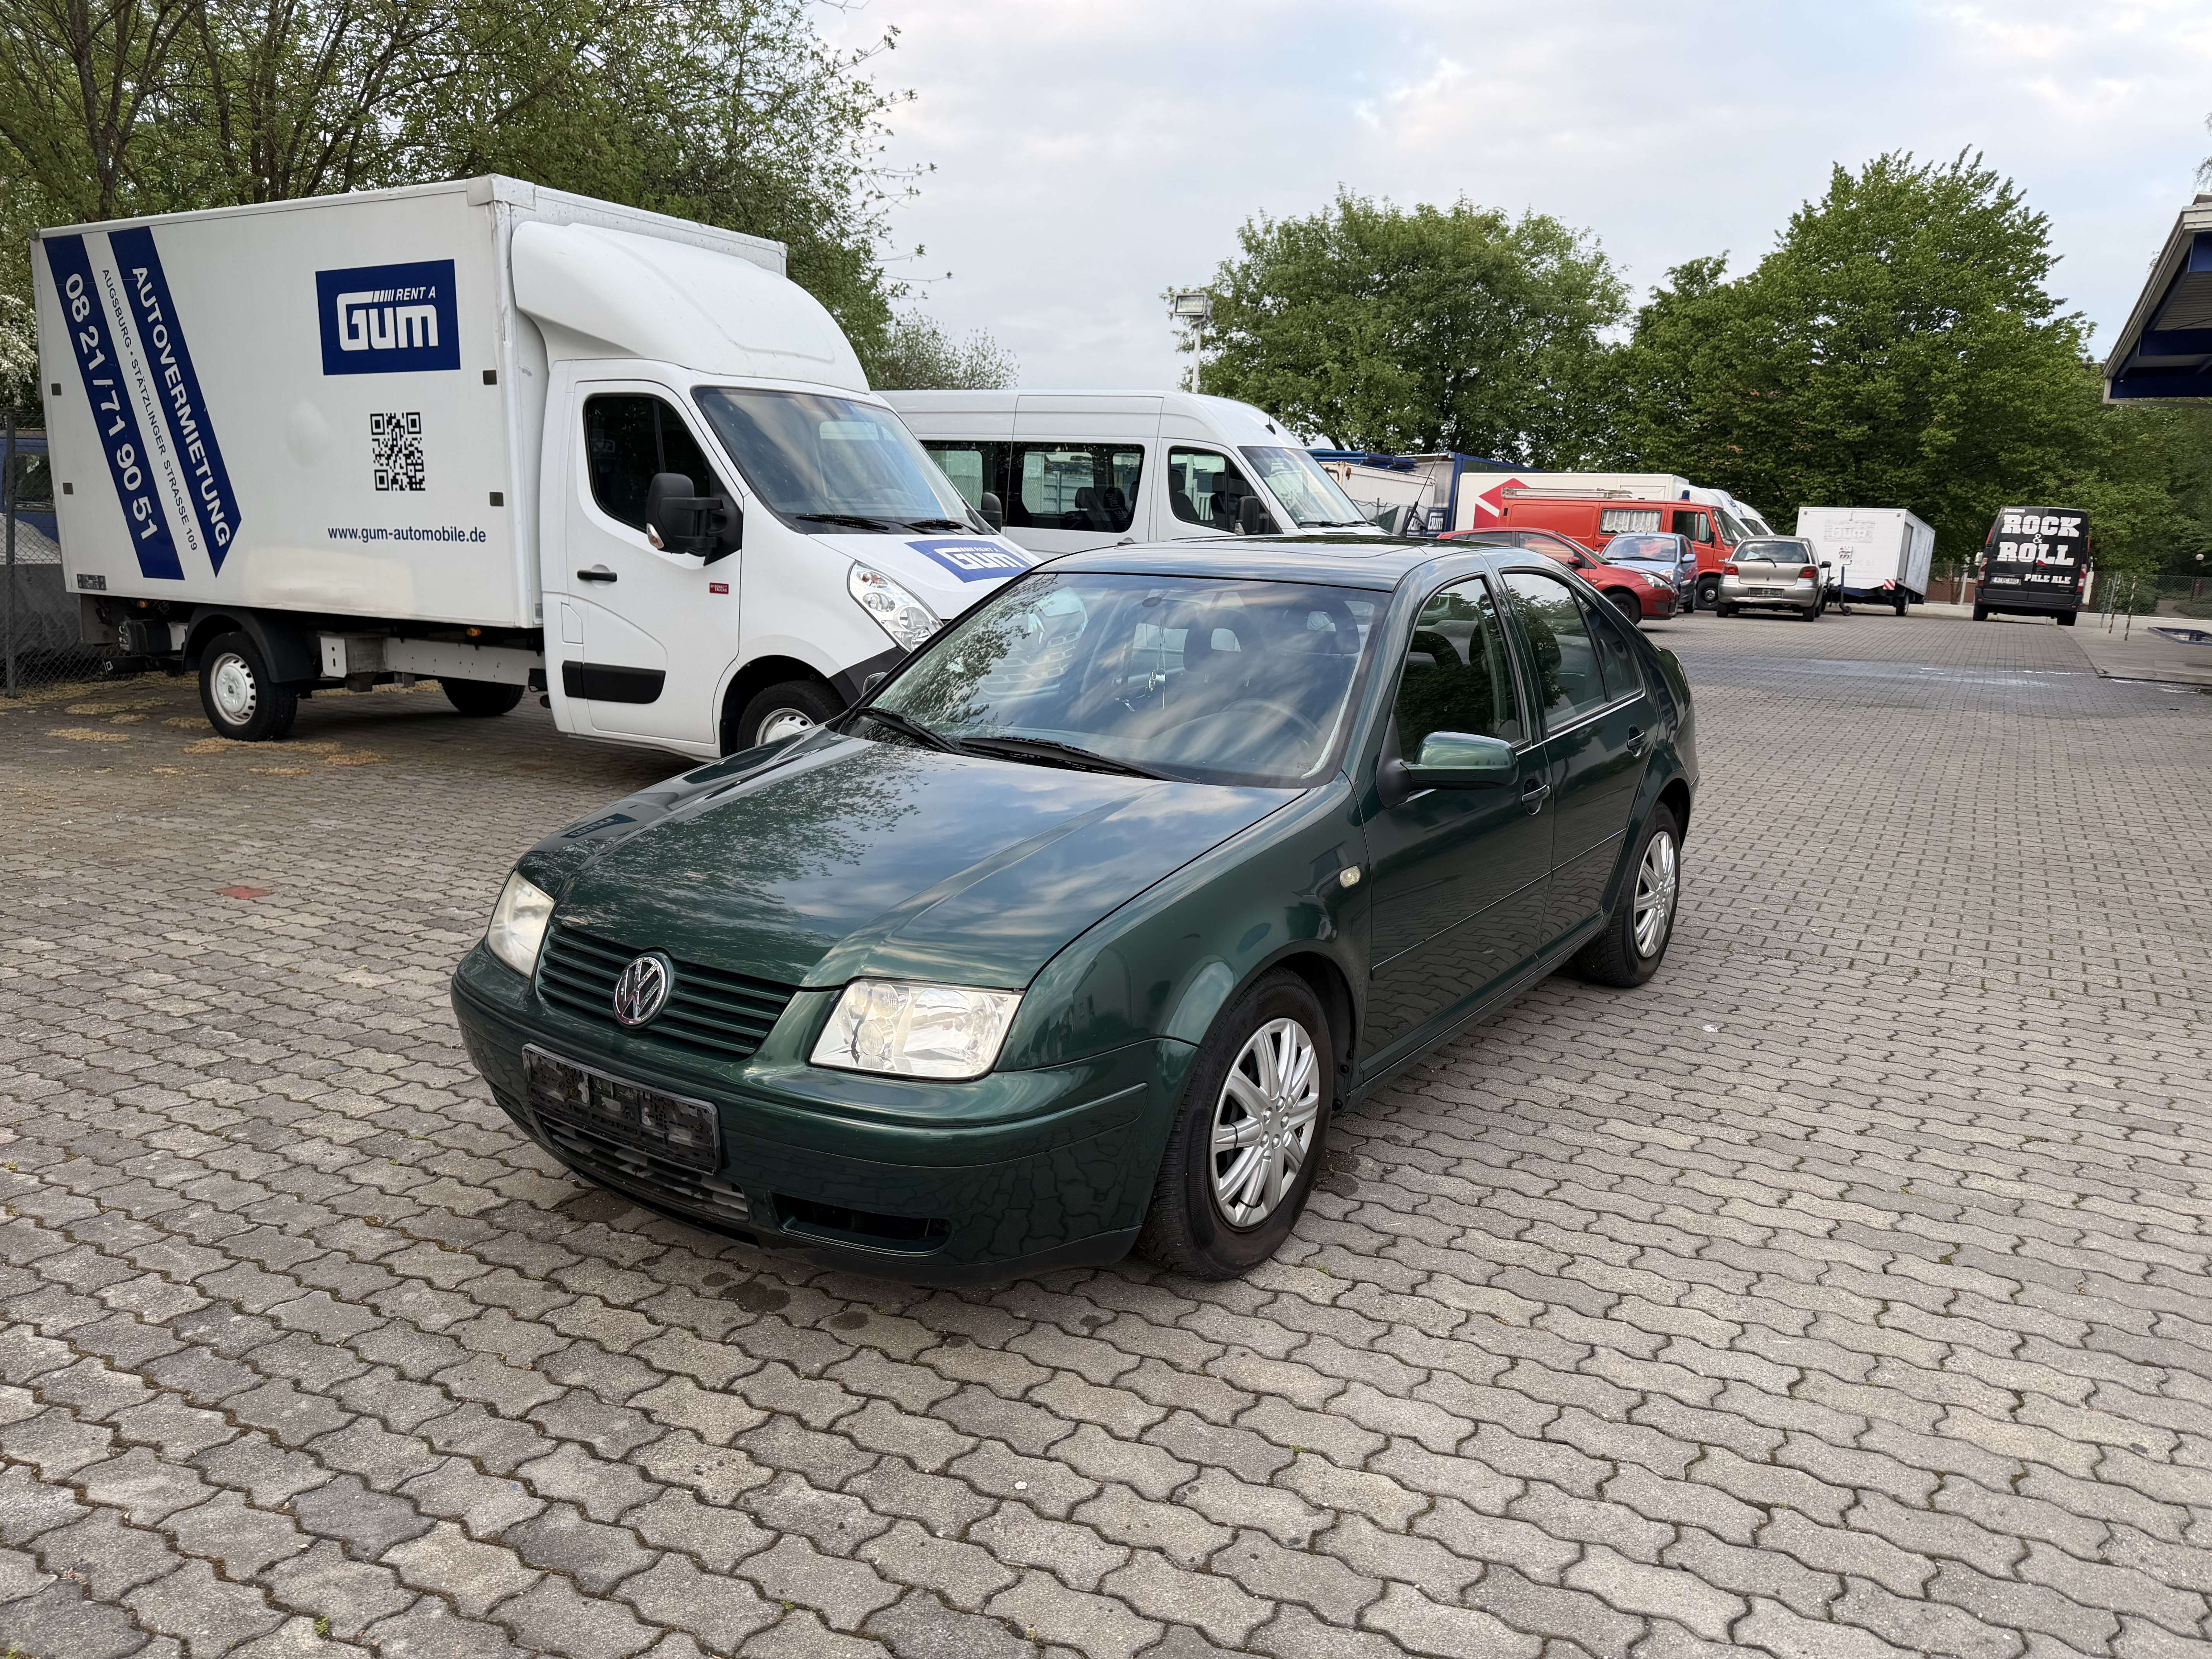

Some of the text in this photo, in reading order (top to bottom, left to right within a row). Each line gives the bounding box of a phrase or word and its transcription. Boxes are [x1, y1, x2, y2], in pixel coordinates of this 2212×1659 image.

[395, 286, 436, 301] RENT A
[102, 270, 198, 550] AUGSBURG STÄTZLINGER STRASSE 109
[132, 267, 230, 547] AUTOVERMIETUNG
[328, 526, 486, 543] www.gum-automobile.de
[2001, 515, 2081, 537] ROCK
[2033, 534, 2042, 544] &
[1997, 542, 2075, 566] ROLL
[2025, 574, 2051, 583] PALE
[2051, 575, 2071, 584] ALE
